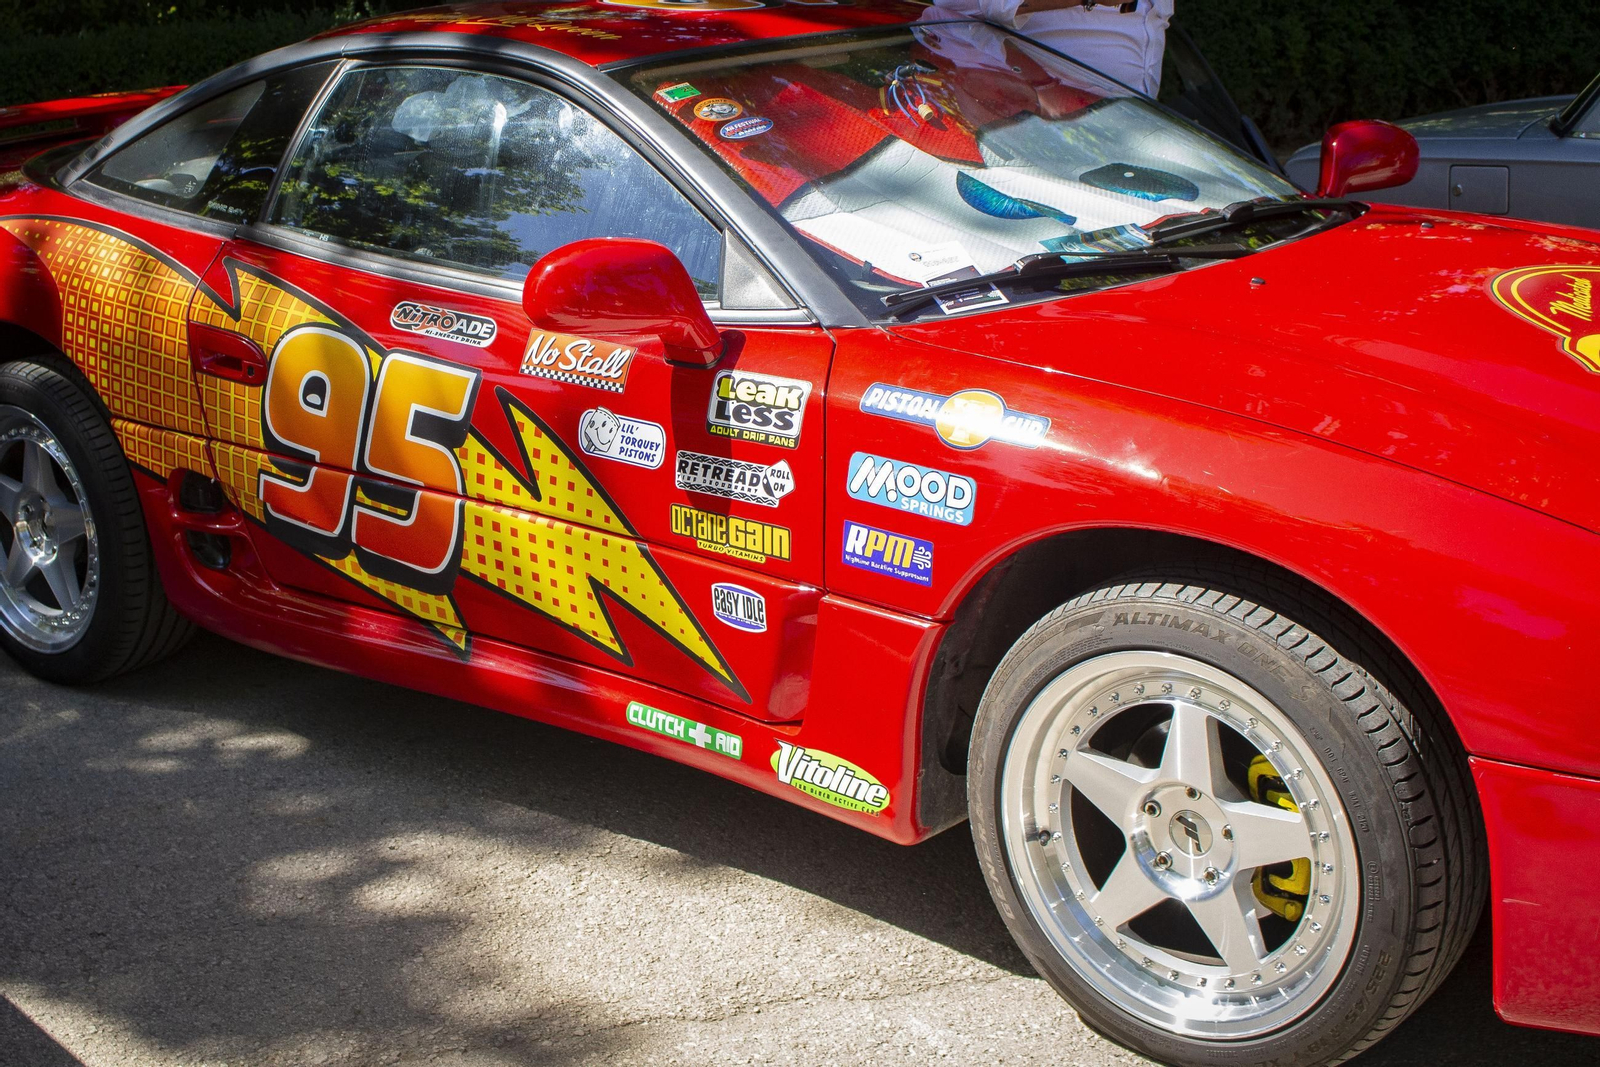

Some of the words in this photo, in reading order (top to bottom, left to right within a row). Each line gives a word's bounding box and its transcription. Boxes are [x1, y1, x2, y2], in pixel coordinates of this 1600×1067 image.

[460, 336, 482, 346] DRINK
[524, 333, 561, 365] No
[558, 339, 631, 379] Stall
[865, 387, 942, 420] PISTON
[1000, 415, 1044, 437] CUP
[621, 423, 640, 435] LIL'
[710, 425, 740, 437] ADULT
[742, 430, 766, 442] DRIP
[768, 435, 796, 448] PANS
[259, 326, 478, 575] 95
[618, 447, 657, 463] PISTONS
[620, 435, 661, 452] TORQUEY
[677, 460, 761, 487] RETREAD
[769, 468, 791, 480] ROLL
[849, 455, 974, 510] MOOD
[773, 482, 787, 493] ON
[900, 497, 964, 523] SPRINGS
[698, 541, 725, 552] TURBO
[845, 524, 915, 568] RPM
[1112, 611, 1233, 645] ALTIMAX
[1237, 641, 1295, 683] ONE
[628, 703, 686, 739] CLUTCH
[715, 732, 741, 757] AID
[776, 739, 888, 808] Vitoline
[833, 796, 859, 810] ACTIVE
[861, 806, 880, 817] CARS
